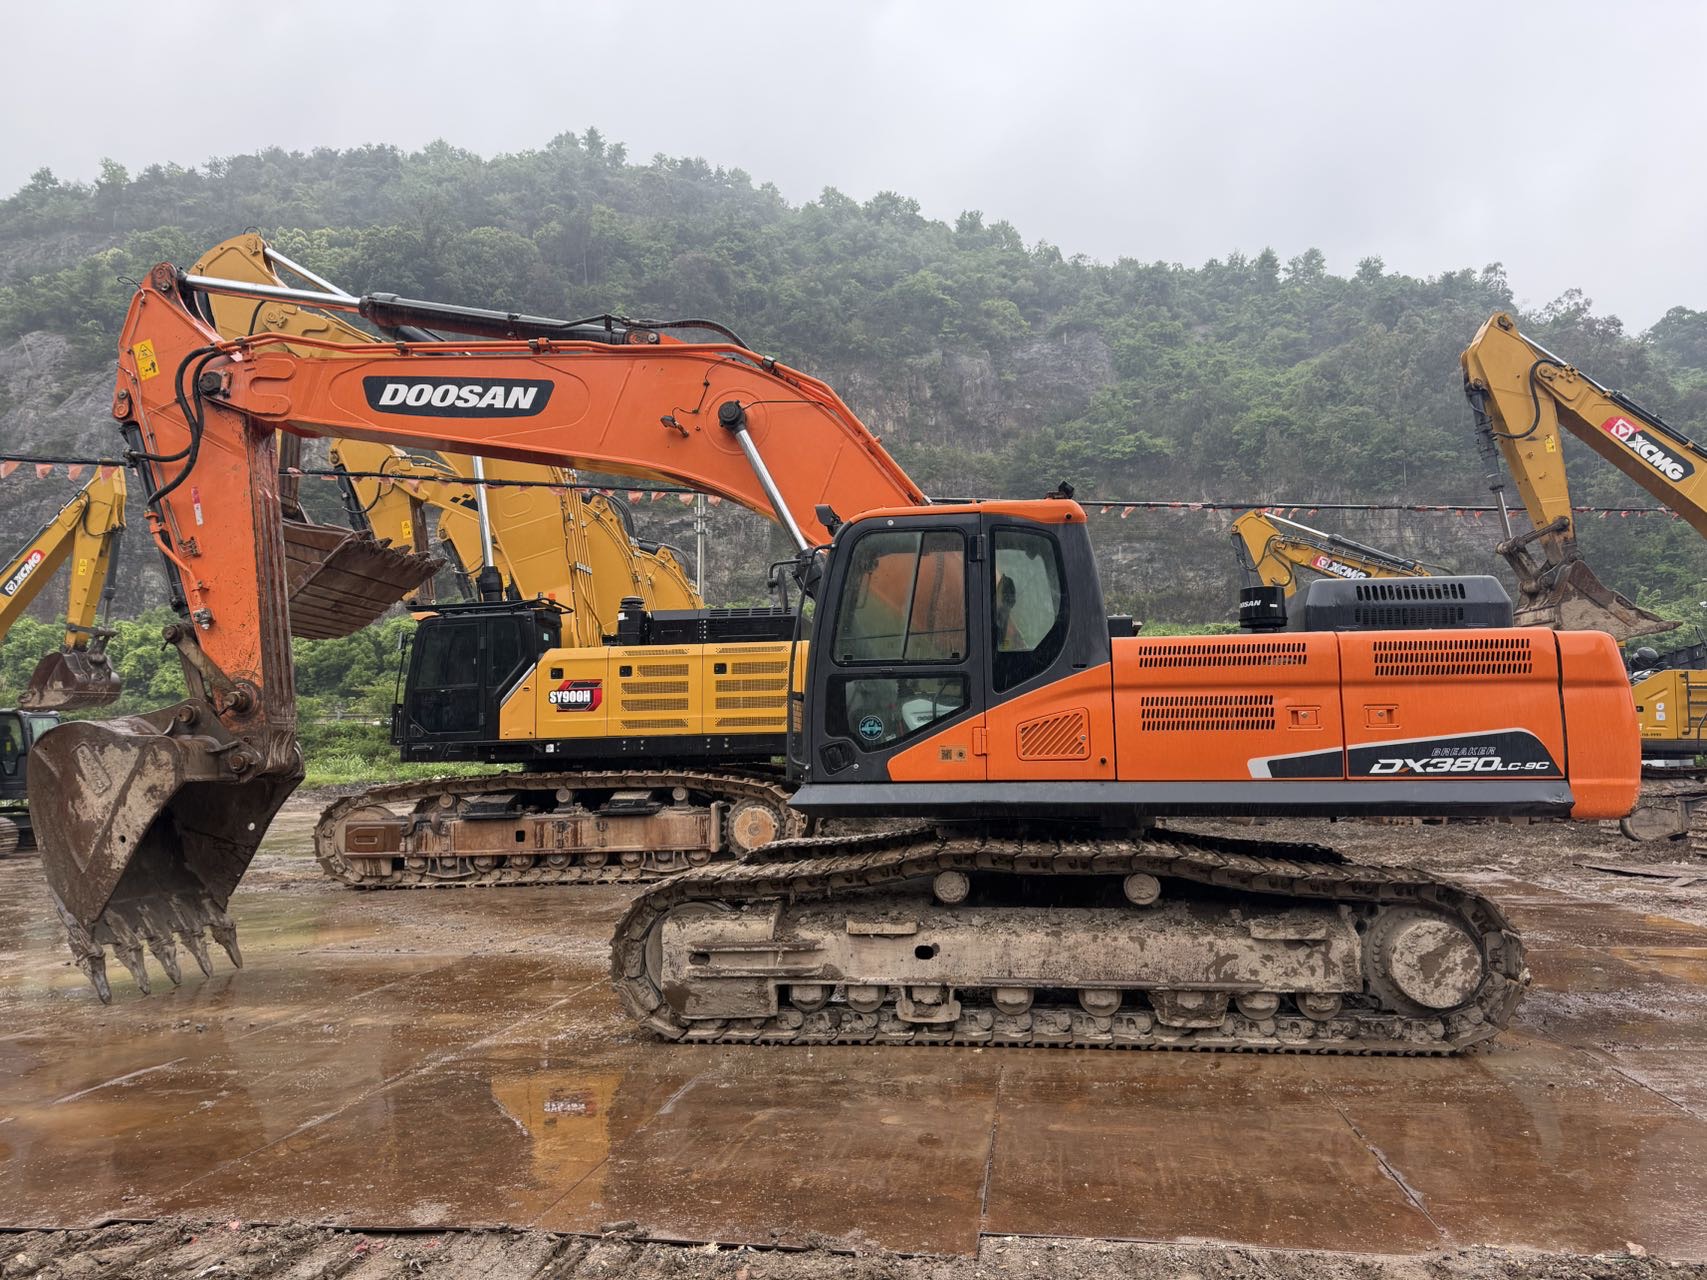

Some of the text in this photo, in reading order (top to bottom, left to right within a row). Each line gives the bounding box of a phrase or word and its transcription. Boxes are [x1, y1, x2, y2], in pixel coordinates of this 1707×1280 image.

[378, 383, 538, 410] DOOSAN
[1625, 433, 1685, 481] XCMG
[13, 551, 42, 586] XCMG
[549, 690, 591, 704] SY900H
[1431, 746, 1497, 757] BREAKER
